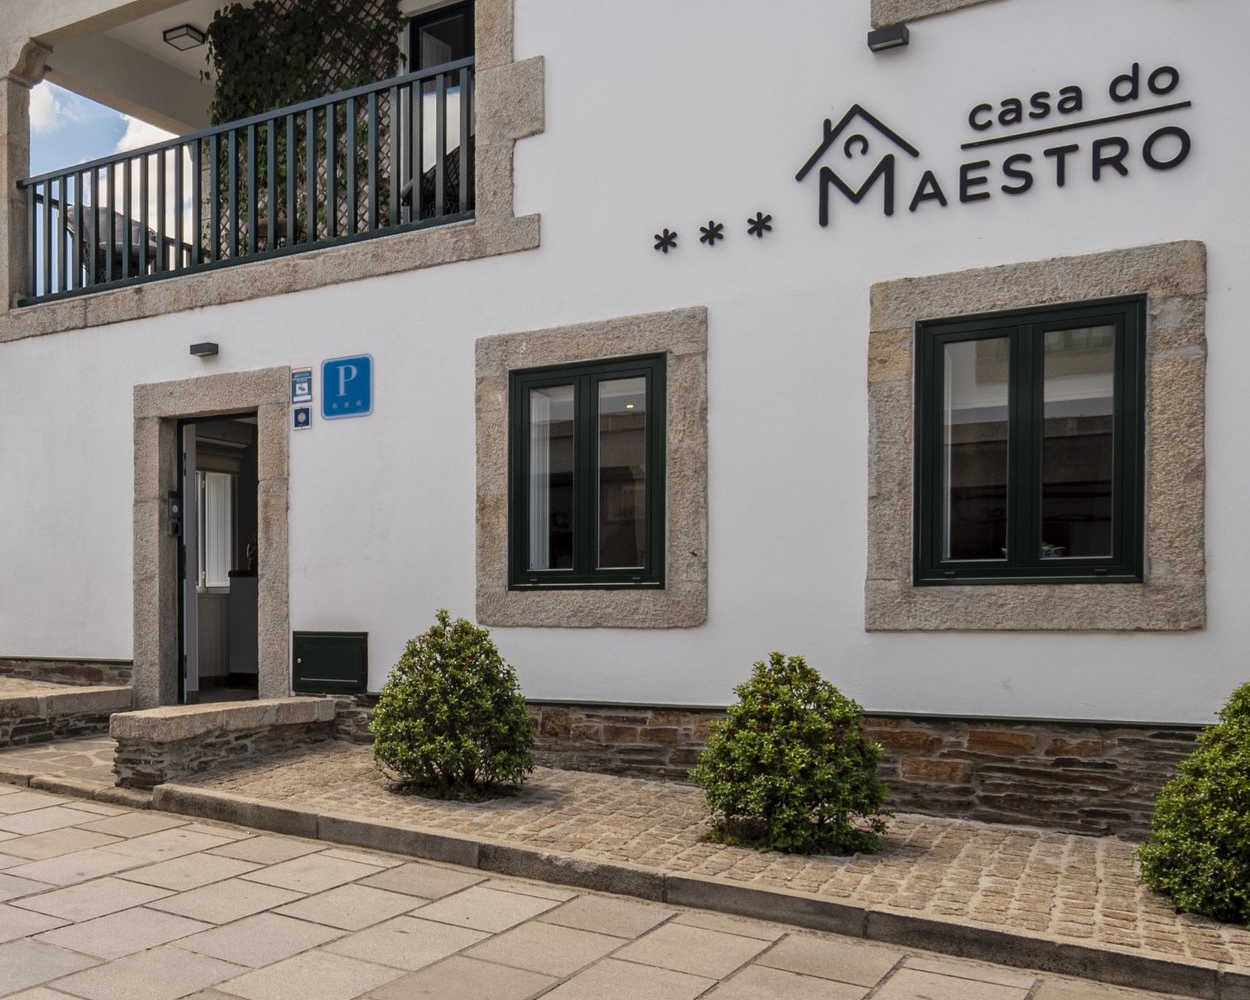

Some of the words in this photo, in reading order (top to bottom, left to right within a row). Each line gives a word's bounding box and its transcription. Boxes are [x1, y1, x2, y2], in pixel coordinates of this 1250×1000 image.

[968, 85, 1083, 132] casa
[1108, 62, 1180, 104] do
[818, 126, 1192, 228] MAESTRO
[336, 365, 358, 397] P
